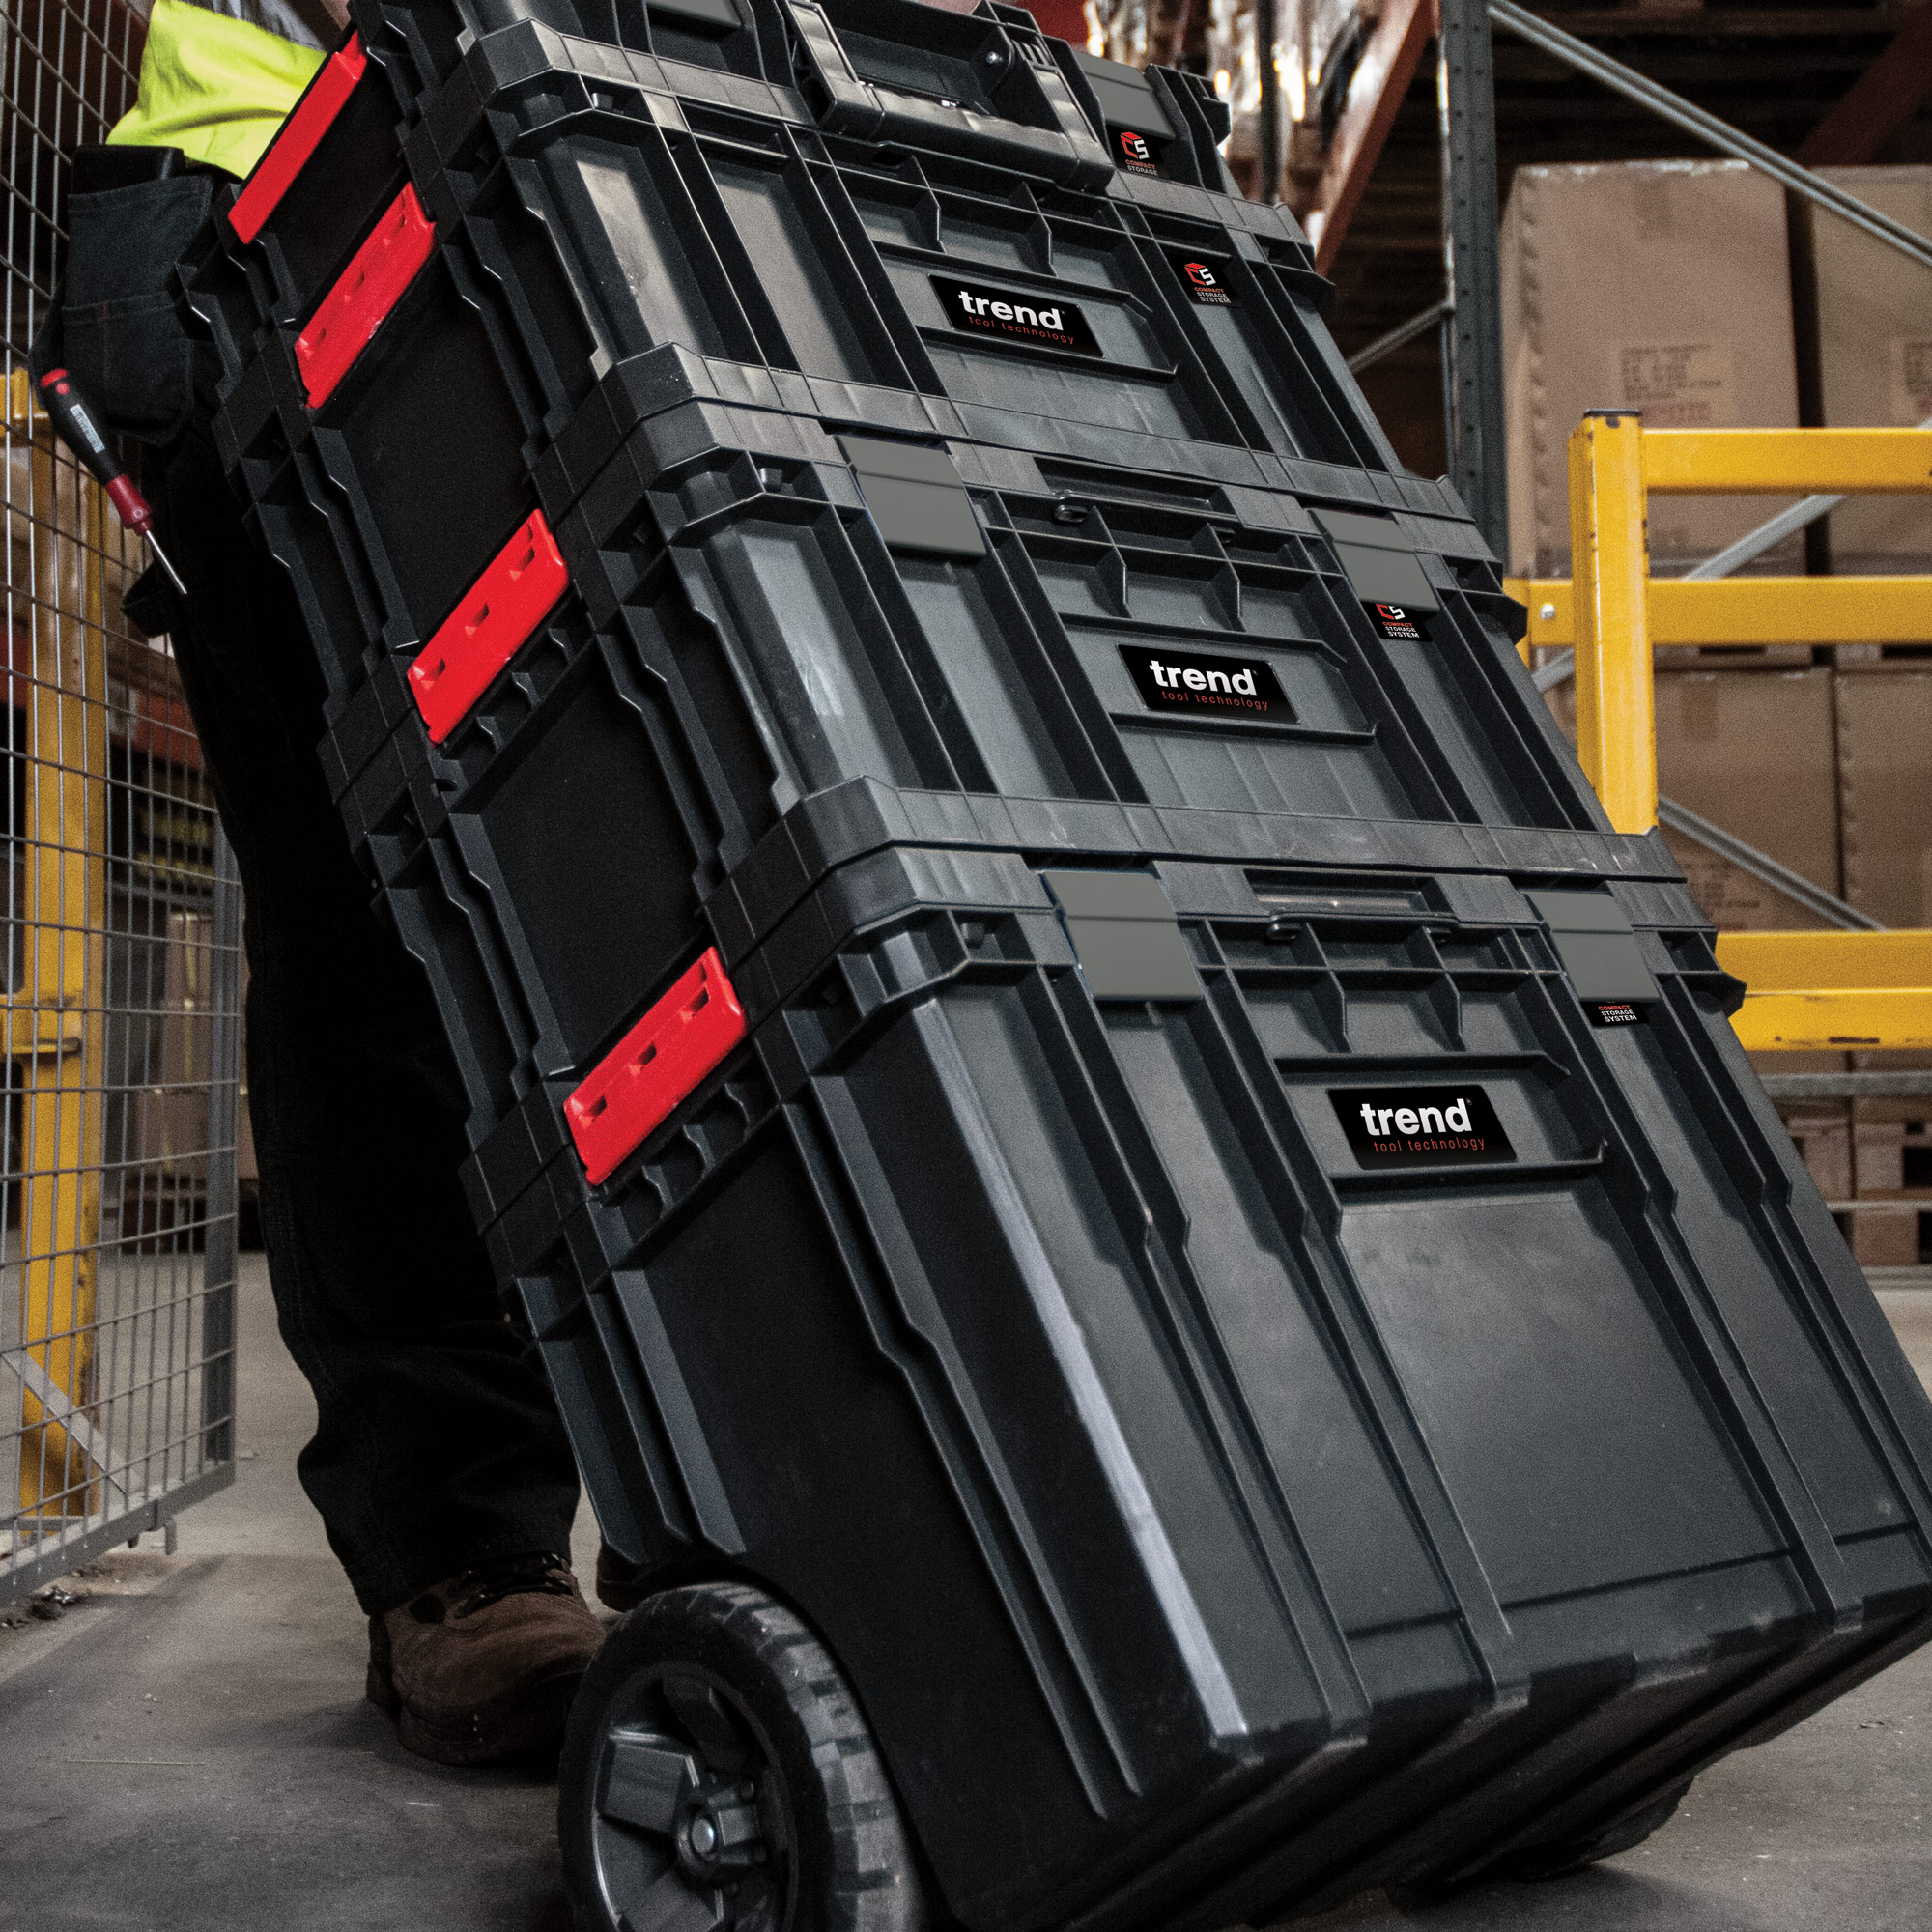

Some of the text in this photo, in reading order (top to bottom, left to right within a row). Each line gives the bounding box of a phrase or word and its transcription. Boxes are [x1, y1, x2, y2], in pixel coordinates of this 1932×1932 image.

[1125, 159, 1156, 170] COMPACT
[1127, 165, 1158, 176] STORAGE
[1200, 296, 1232, 304] SYSTEM
[958, 290, 1064, 331] trend
[969, 316, 1074, 345] tool technology
[1149, 660, 1258, 696] trend
[1161, 690, 1268, 711] tool technology
[1604, 1014, 1638, 1023] SYSTEM
[1360, 1097, 1473, 1136] trend
[1373, 1136, 1485, 1152] tool technology
